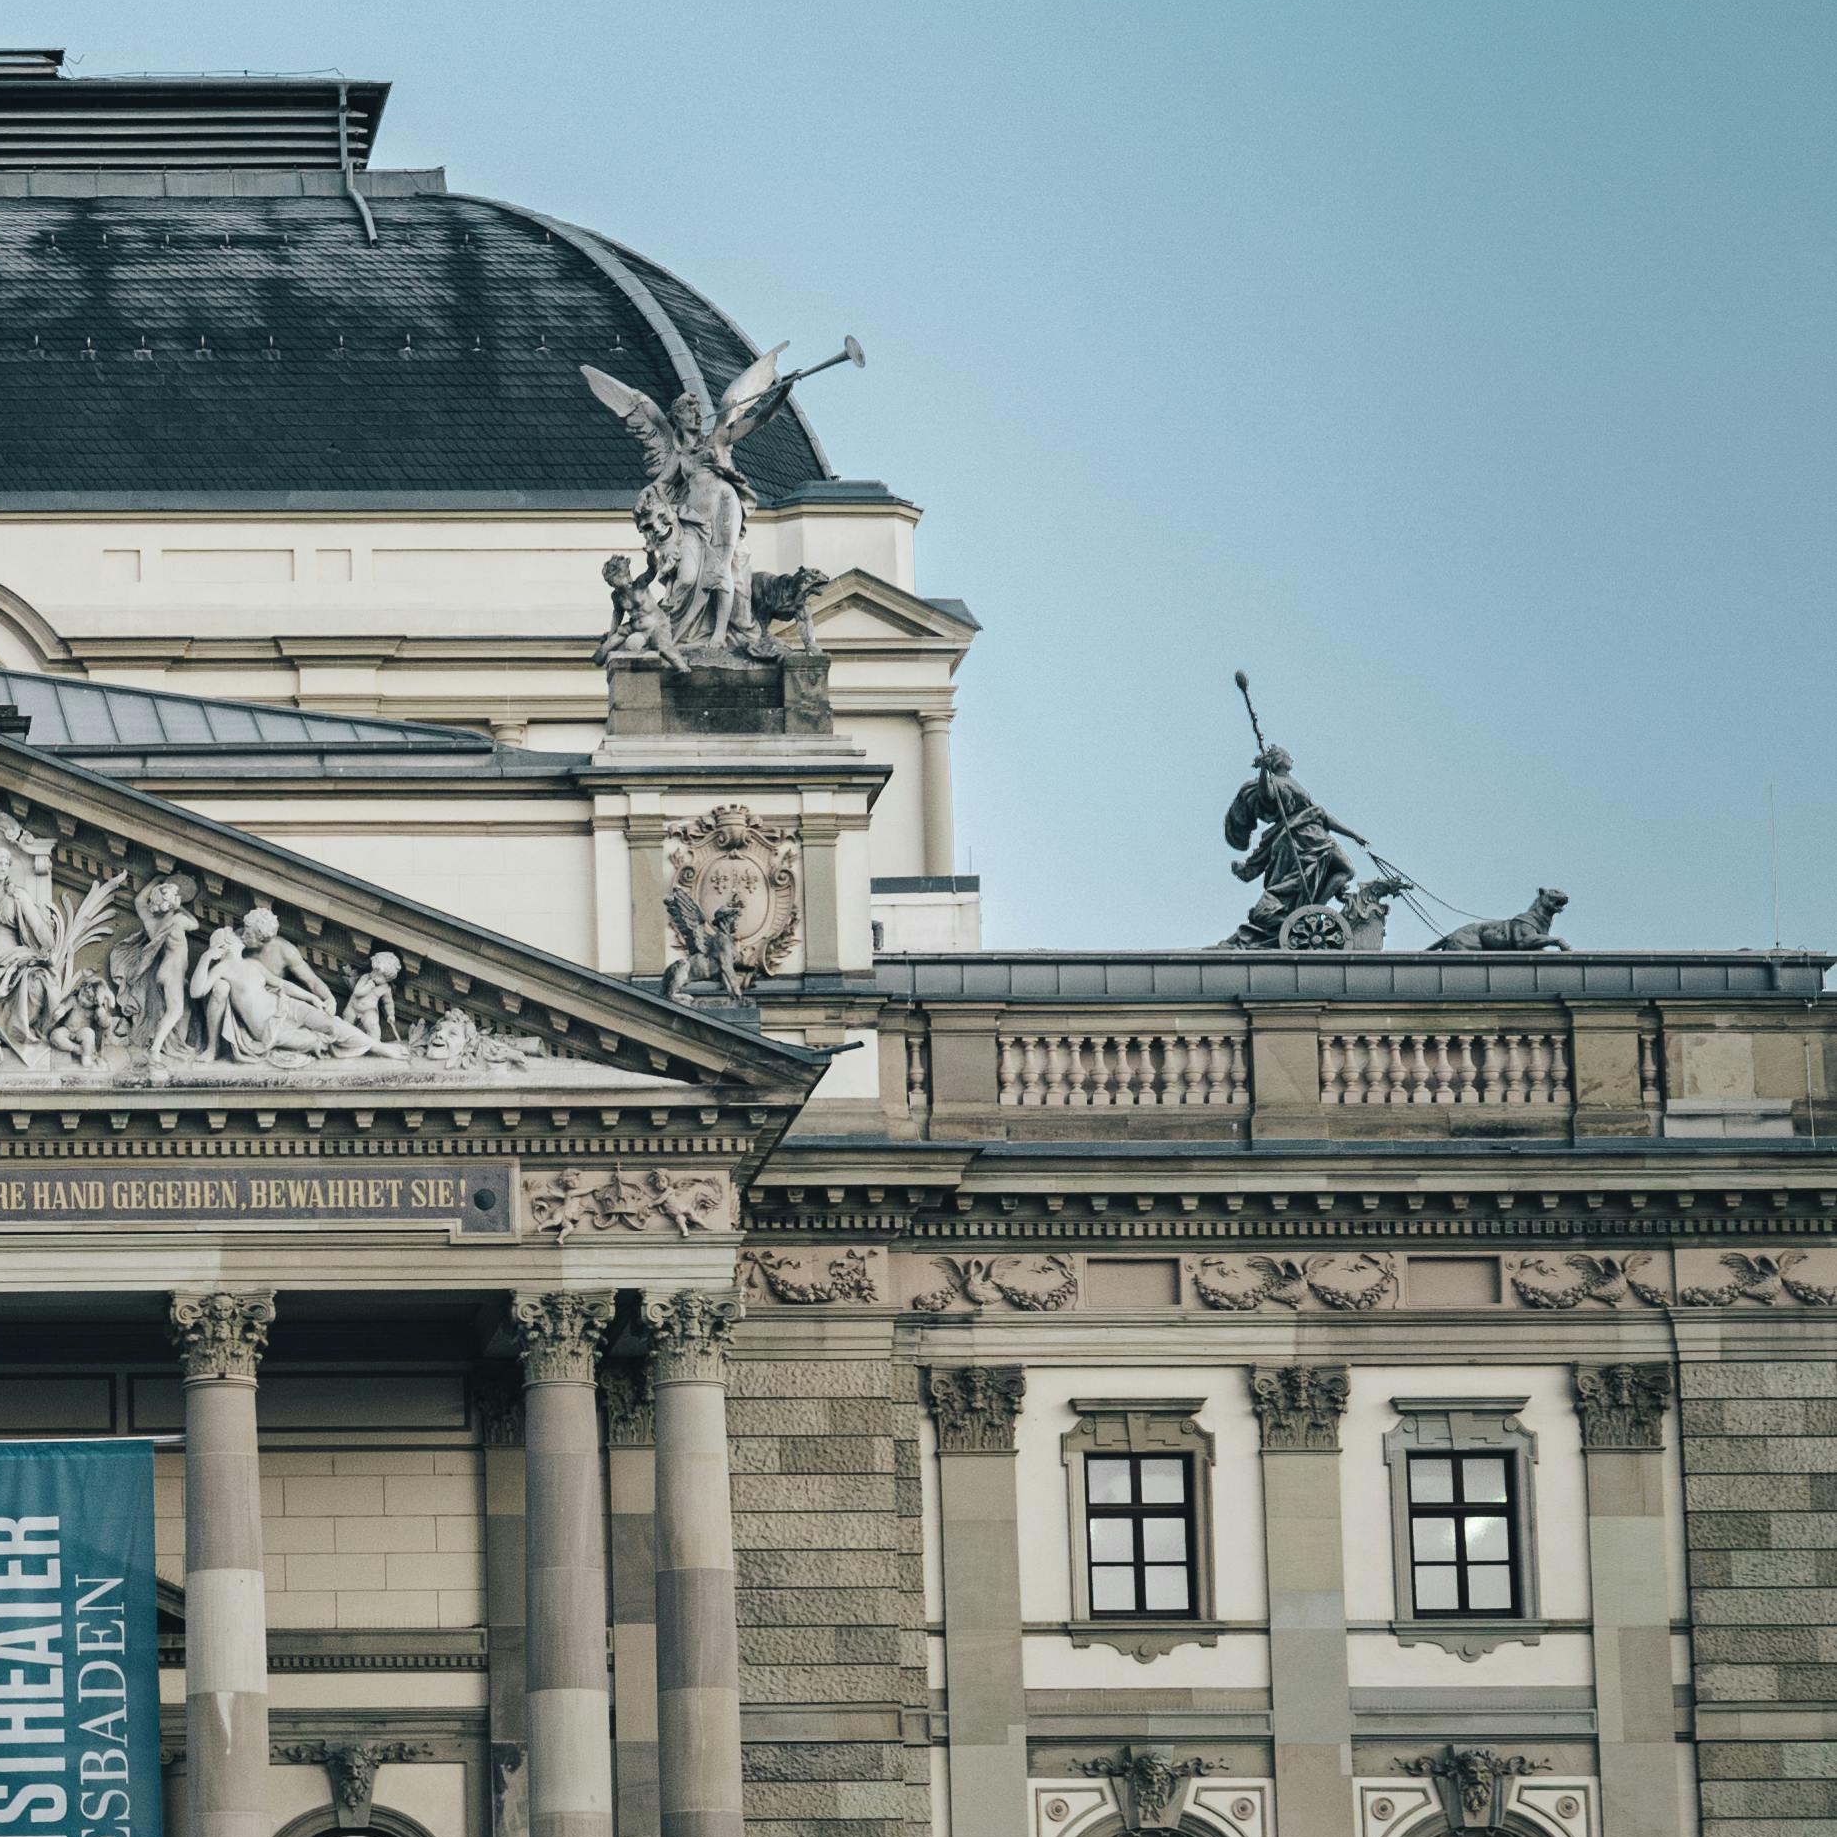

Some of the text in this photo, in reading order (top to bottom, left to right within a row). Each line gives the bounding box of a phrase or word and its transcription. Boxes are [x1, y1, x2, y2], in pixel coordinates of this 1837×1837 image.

[33, 1180, 105, 1210] HAND
[112, 1180, 247, 1211] GEGEBEN,
[250, 1179, 403, 1209] BEWAHRET
[411, 1179, 467, 1208] SIE!
